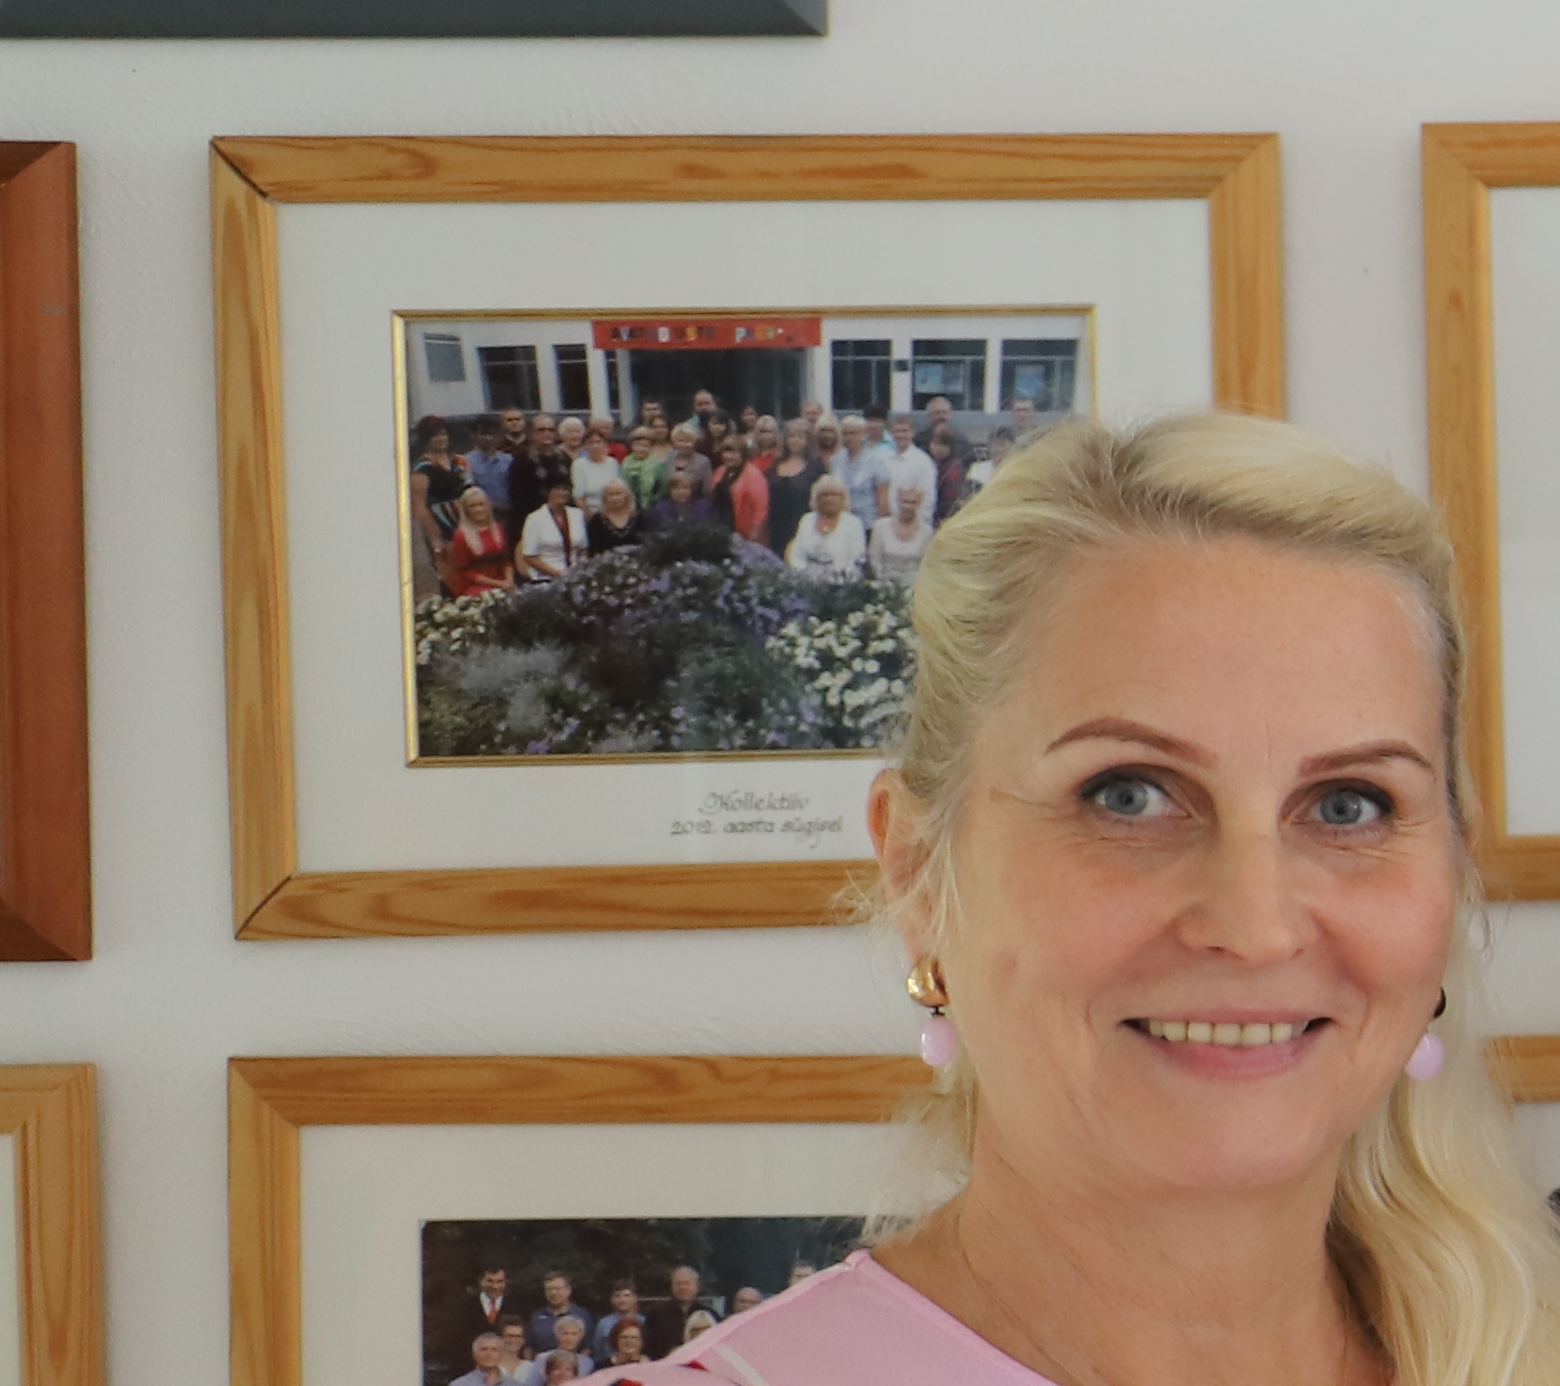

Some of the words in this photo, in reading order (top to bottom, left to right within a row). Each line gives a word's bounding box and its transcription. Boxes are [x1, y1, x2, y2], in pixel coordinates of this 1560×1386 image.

[698, 789, 809, 815] Kollektiiv
[723, 820, 775, 834] aasta
[780, 817, 843, 848] sügisel
